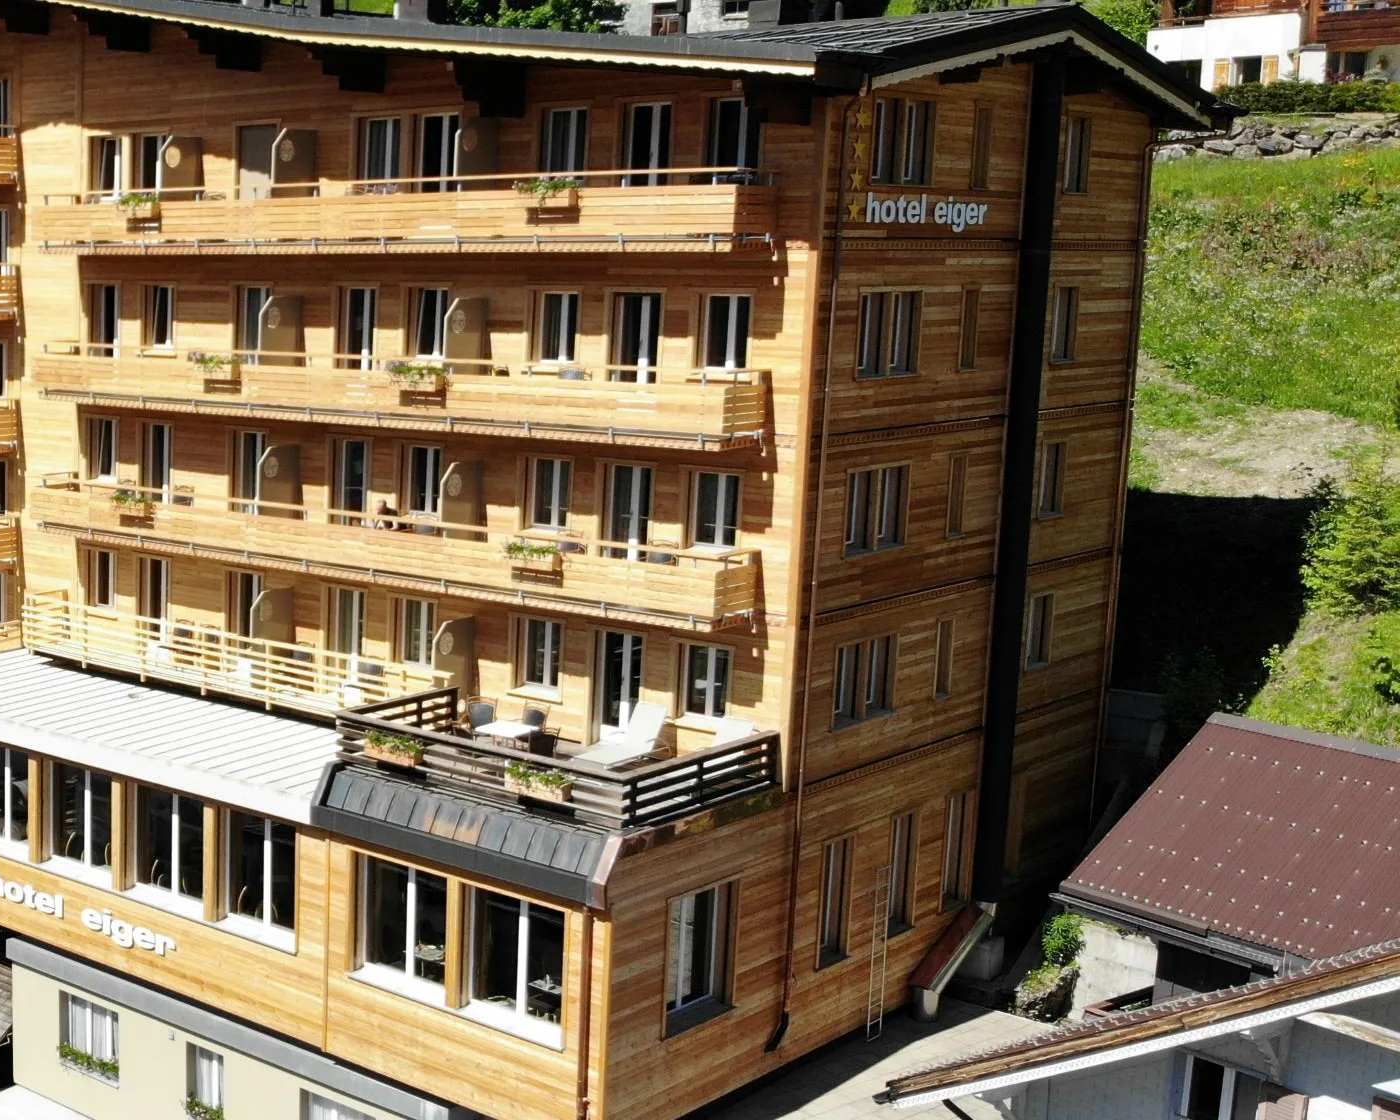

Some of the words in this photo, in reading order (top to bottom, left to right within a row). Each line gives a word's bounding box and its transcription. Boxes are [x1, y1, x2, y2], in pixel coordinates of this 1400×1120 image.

[866, 192, 927, 224] hotel
[934, 196, 988, 233] eiger
[81, 909, 177, 957] eiger
